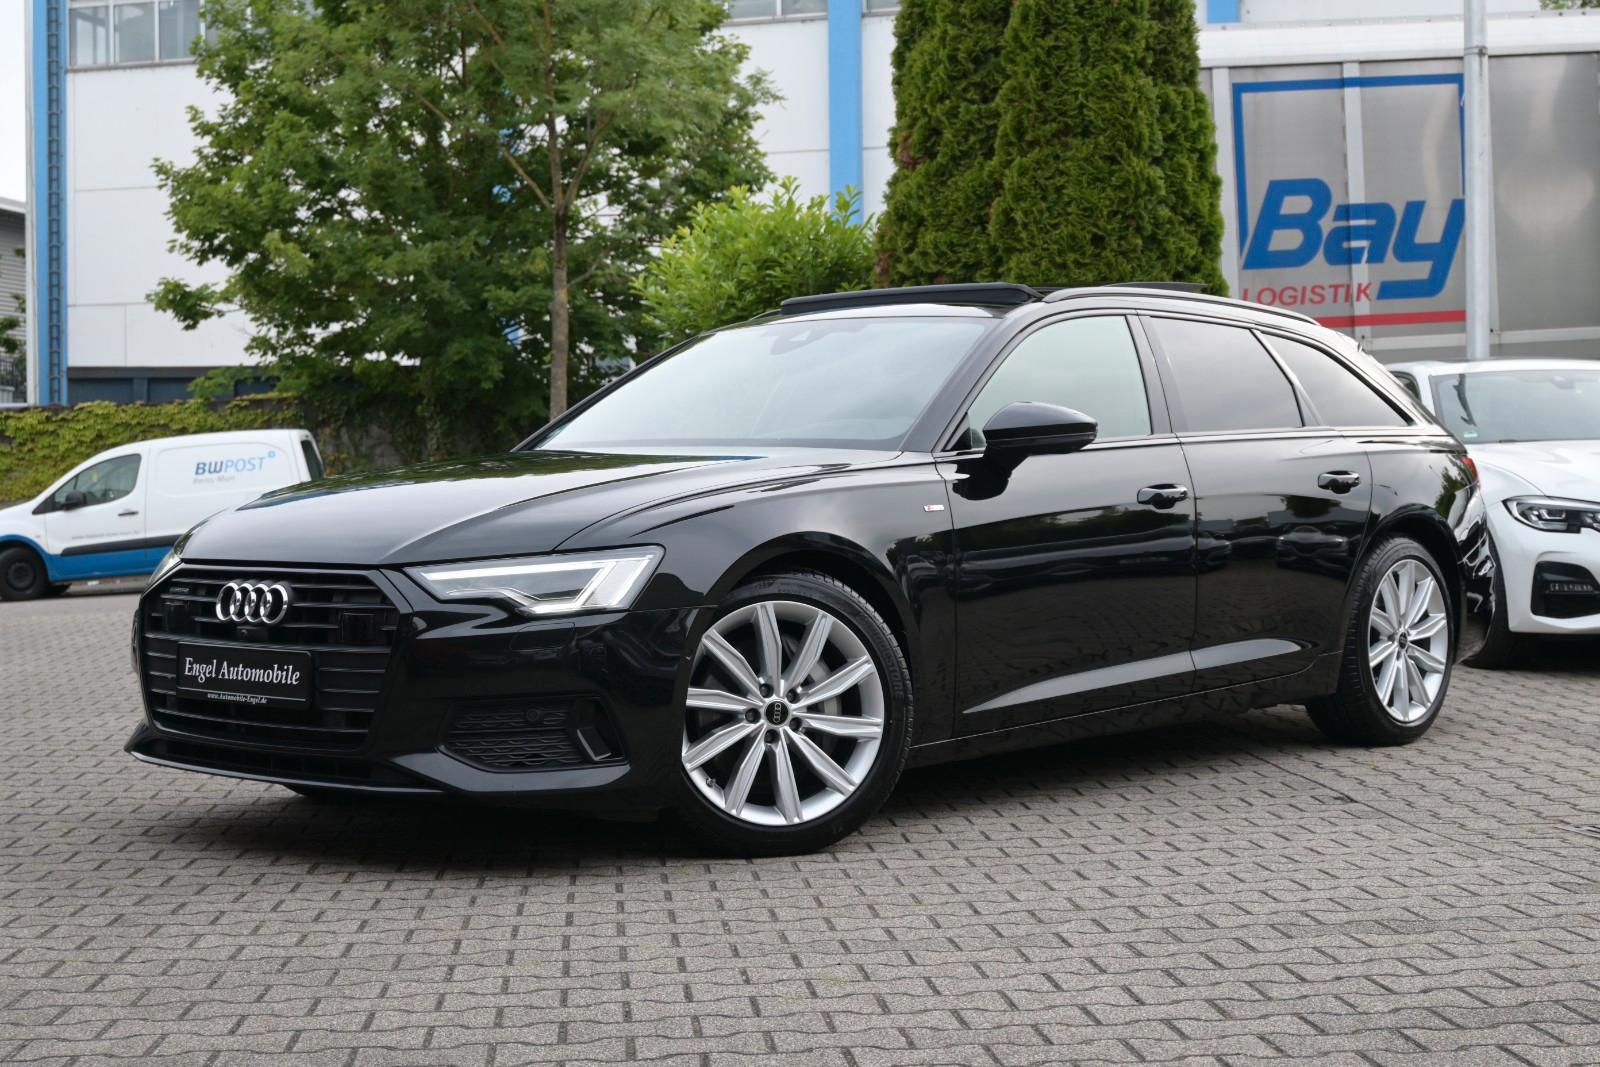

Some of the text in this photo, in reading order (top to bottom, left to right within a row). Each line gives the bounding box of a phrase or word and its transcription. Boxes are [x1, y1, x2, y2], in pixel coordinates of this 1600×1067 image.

[1242, 177, 1465, 300] Bay
[184, 657, 301, 685] Engel Automobile
